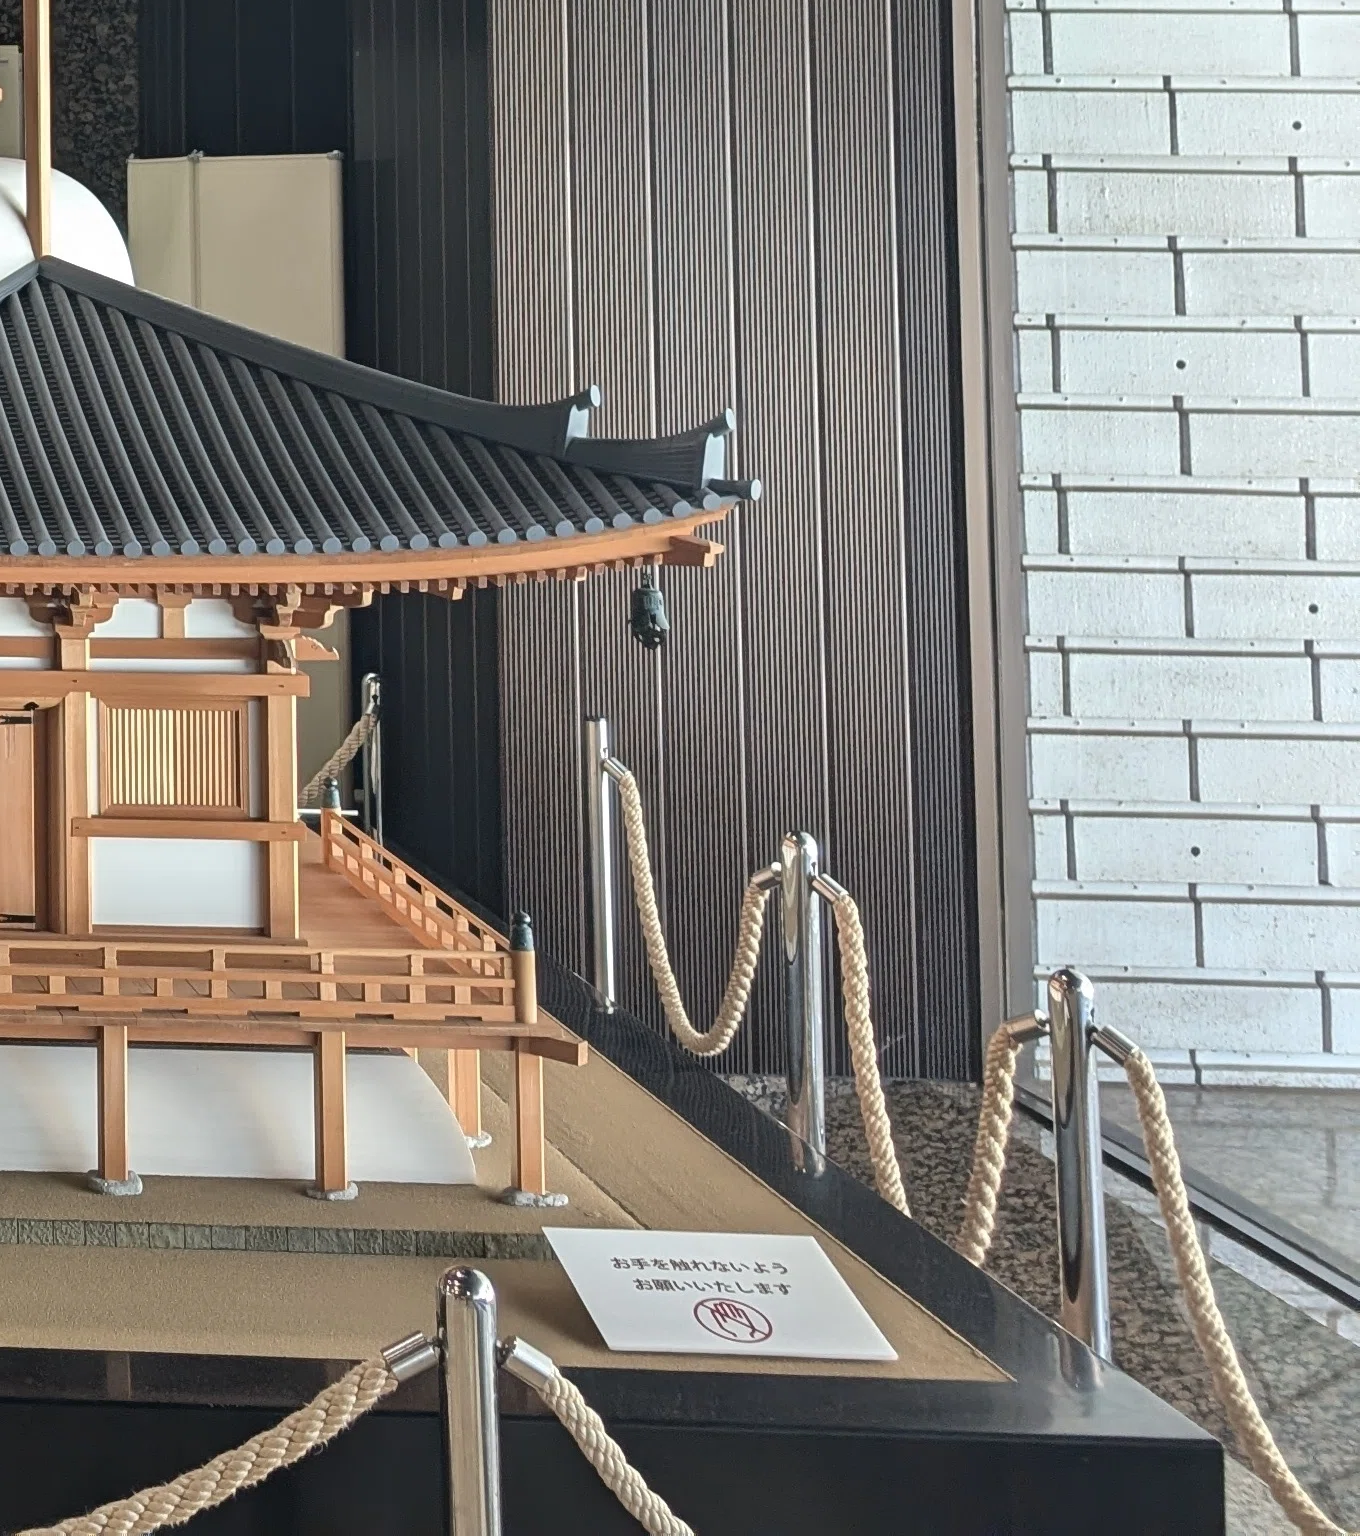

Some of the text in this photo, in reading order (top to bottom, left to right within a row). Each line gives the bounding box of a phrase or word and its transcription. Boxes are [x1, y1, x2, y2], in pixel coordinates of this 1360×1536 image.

[610, 1257, 788, 1275] お手を触れないよう
[632, 1278, 791, 1296] お願いいたします
